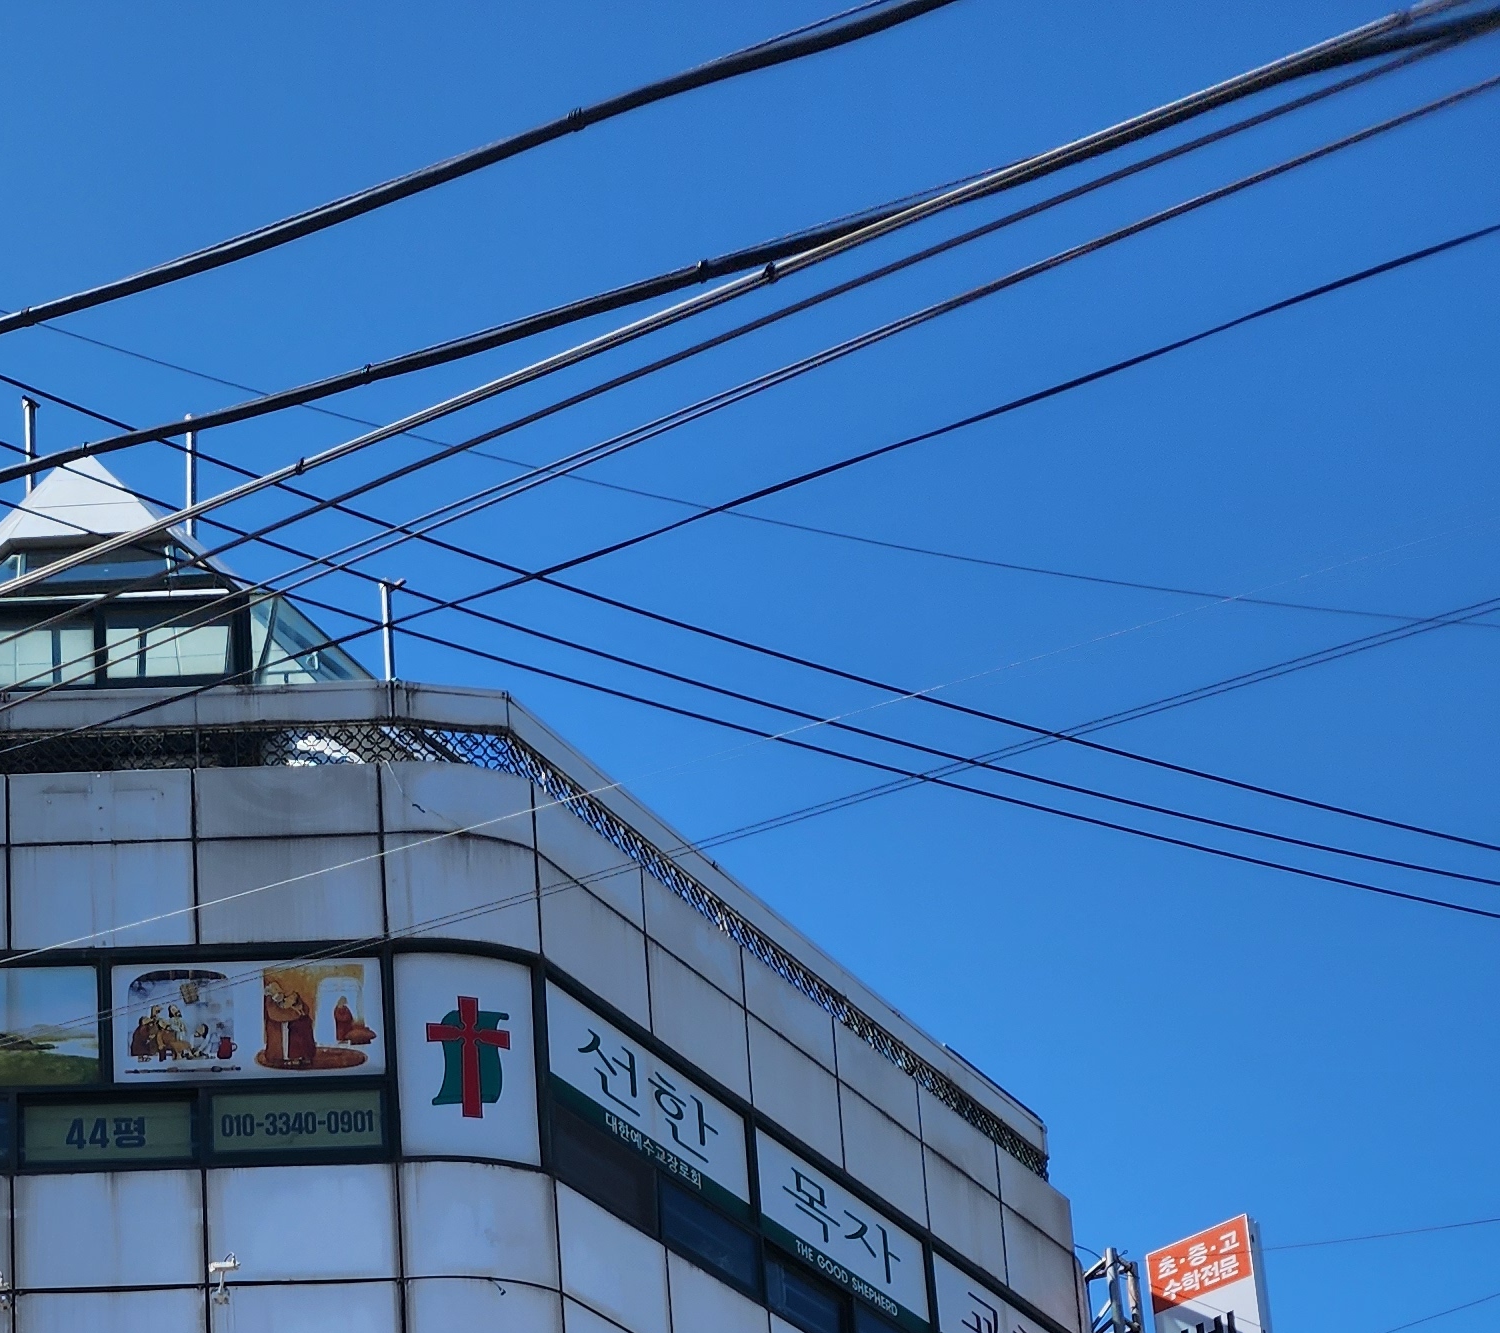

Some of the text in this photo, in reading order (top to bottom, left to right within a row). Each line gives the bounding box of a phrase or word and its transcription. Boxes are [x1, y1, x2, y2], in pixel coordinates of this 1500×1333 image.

[66, 1116, 146, 1149] 44평
[221, 1110, 374, 1137] 010-3340-0901
[578, 1028, 718, 1163] 선한
[782, 1167, 901, 1284] 목자
[605, 1111, 702, 1190] 대한예수교장로회
[795, 1239, 899, 1317] THE GOOD SHEPHERD
[1163, 1255, 1239, 1301] 수학전문
